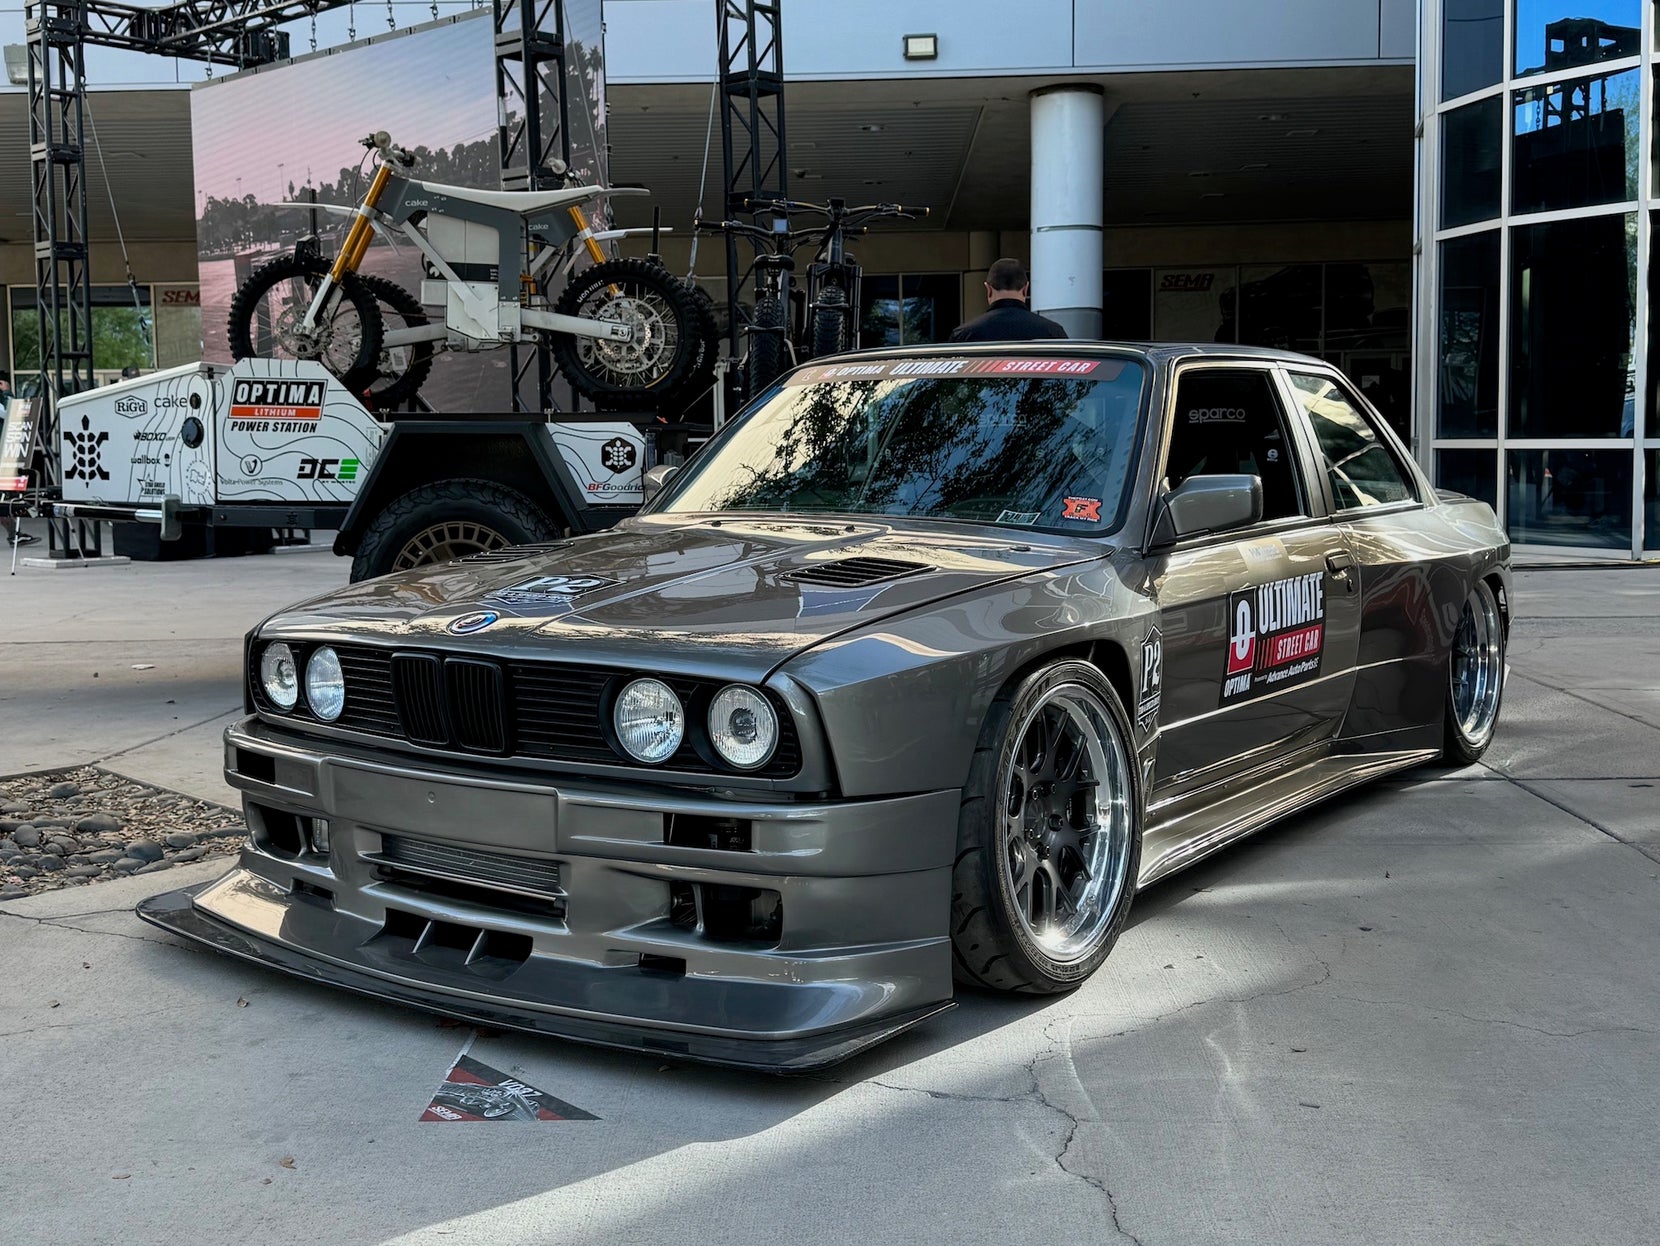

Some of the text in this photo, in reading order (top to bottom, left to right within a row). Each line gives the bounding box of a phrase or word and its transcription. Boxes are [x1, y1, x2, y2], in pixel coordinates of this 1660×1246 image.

[405, 199, 428, 207] cake
[528, 222, 549, 231] cake
[1002, 362, 1056, 373] STREET
[1057, 361, 1091, 373] CAR
[235, 383, 320, 404] OPTIMA
[154, 394, 188, 408] cake
[254, 408, 296, 417] LITHIUM
[231, 421, 317, 433] POWER STATION
[1258, 571, 1324, 635] ULTIMATE
[1276, 628, 1320, 661] STREET CAR
[1141, 640, 1161, 692] P2
[1223, 673, 1252, 698] OPTIMA
